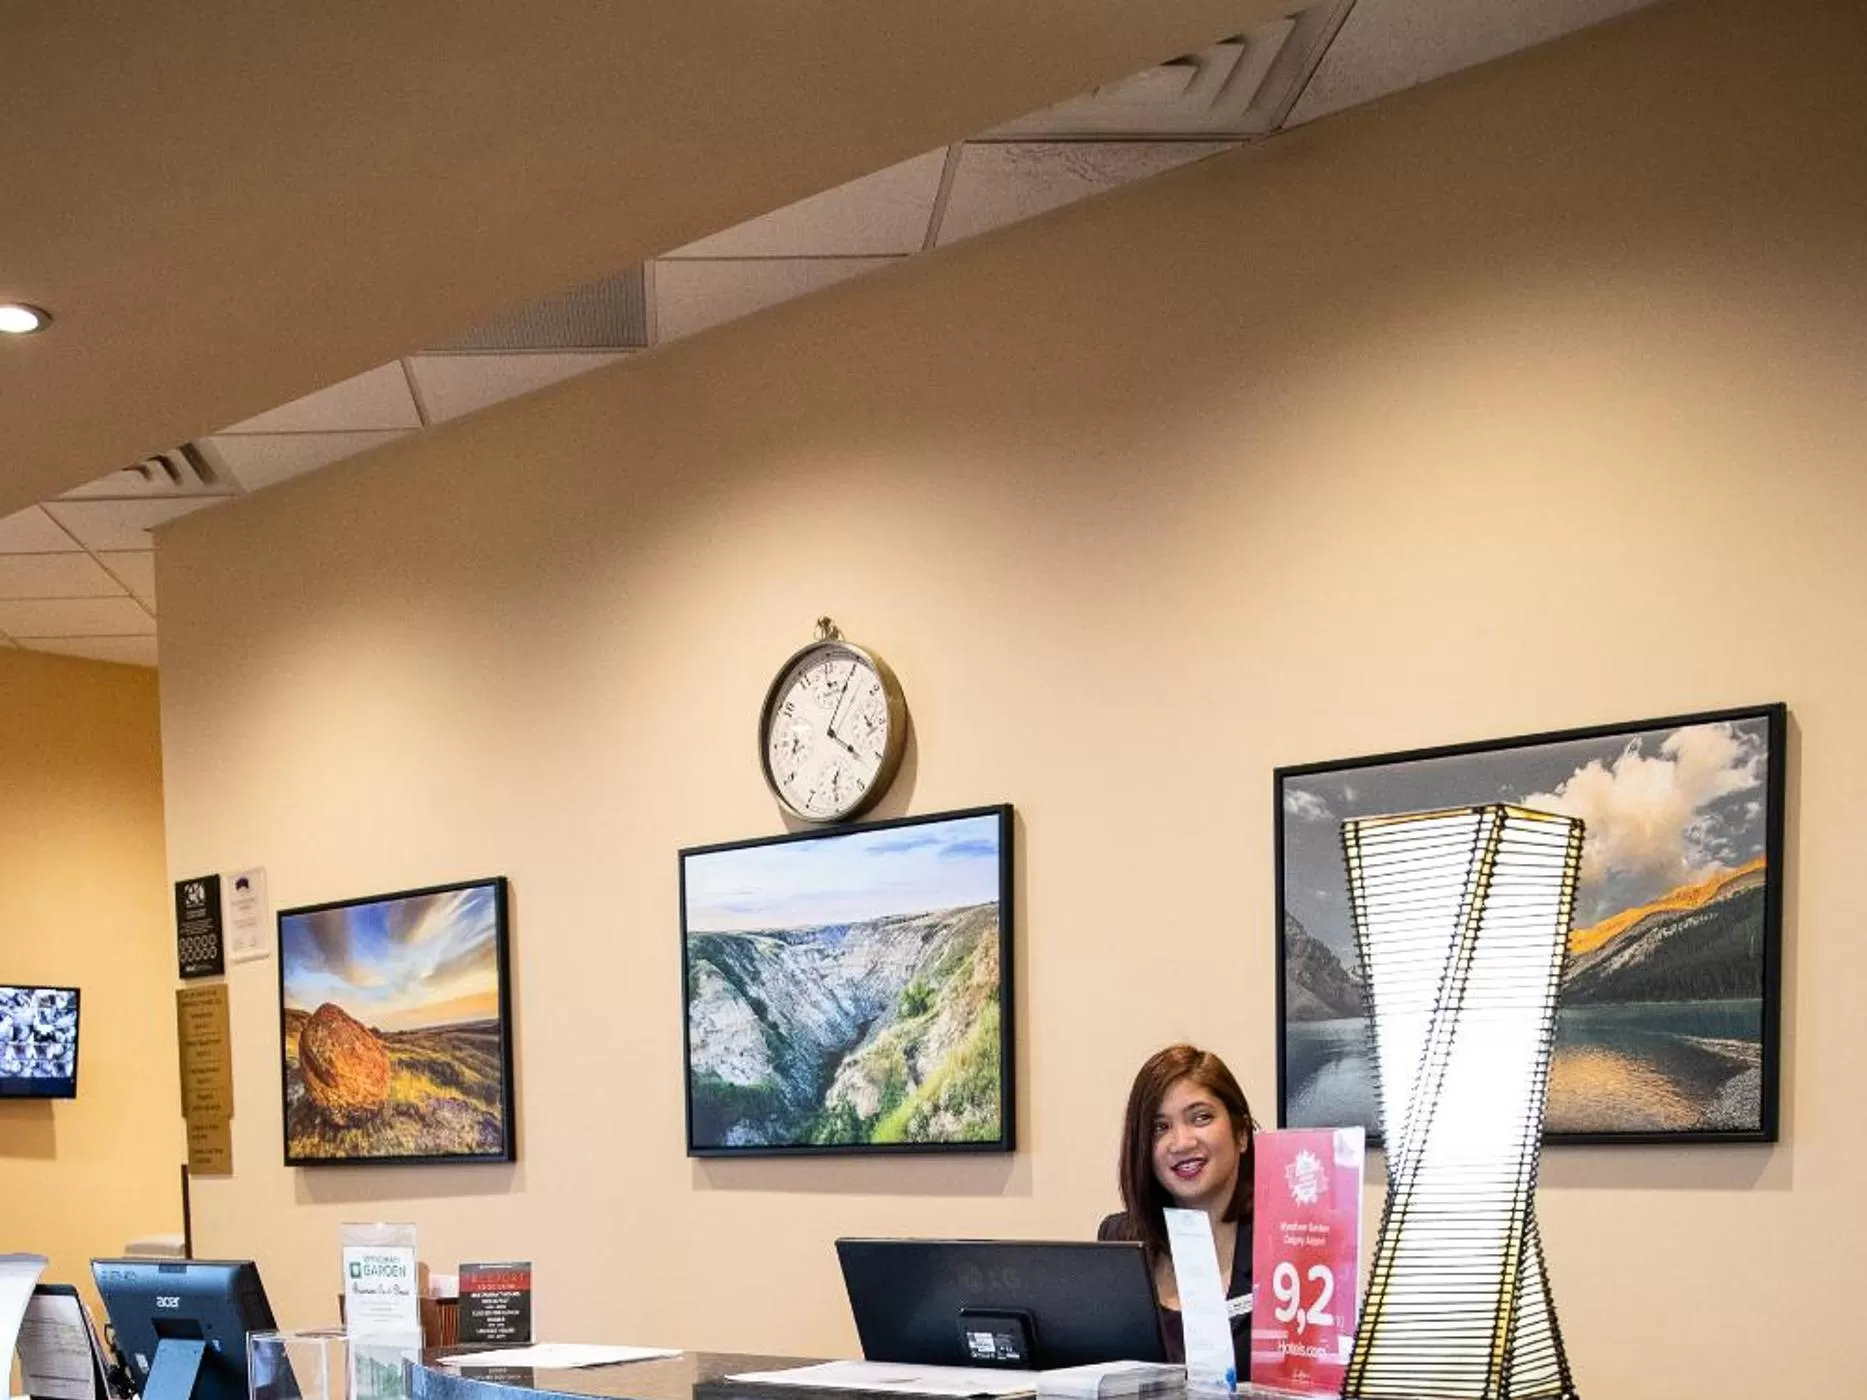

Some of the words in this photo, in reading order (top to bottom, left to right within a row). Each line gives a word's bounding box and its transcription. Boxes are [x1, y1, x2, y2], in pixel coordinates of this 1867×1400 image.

[363, 1264, 406, 1278] GARDEN
[157, 1296, 180, 1308] acer
[1278, 1340, 1328, 1360] Hotels.com
